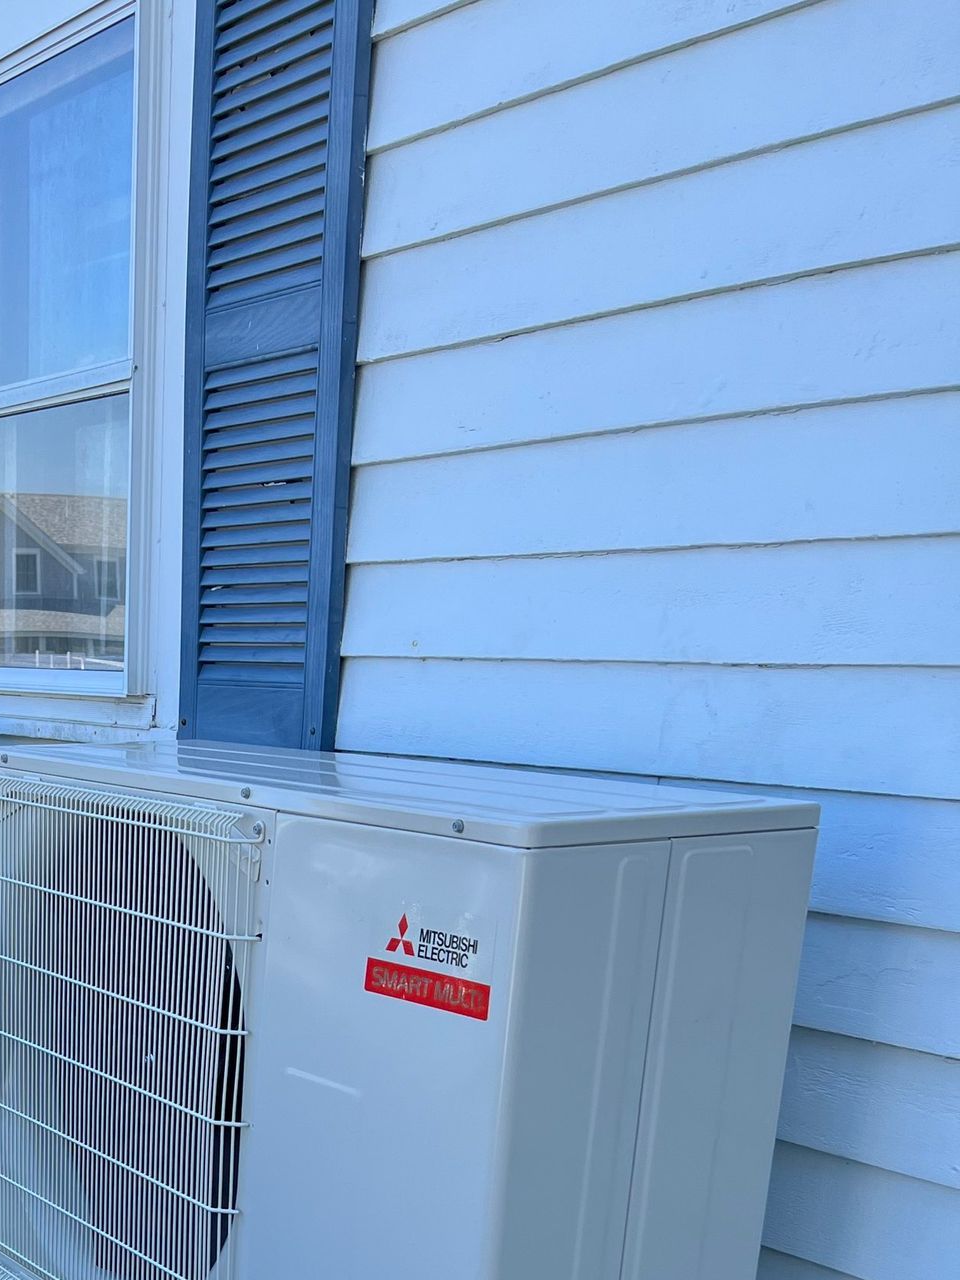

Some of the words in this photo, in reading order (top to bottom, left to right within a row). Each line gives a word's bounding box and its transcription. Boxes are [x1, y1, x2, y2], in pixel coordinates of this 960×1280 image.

[419, 928, 478, 954] MITSUBISHI
[417, 943, 469, 968] ELECTRIC
[371, 966, 432, 998] SMART
